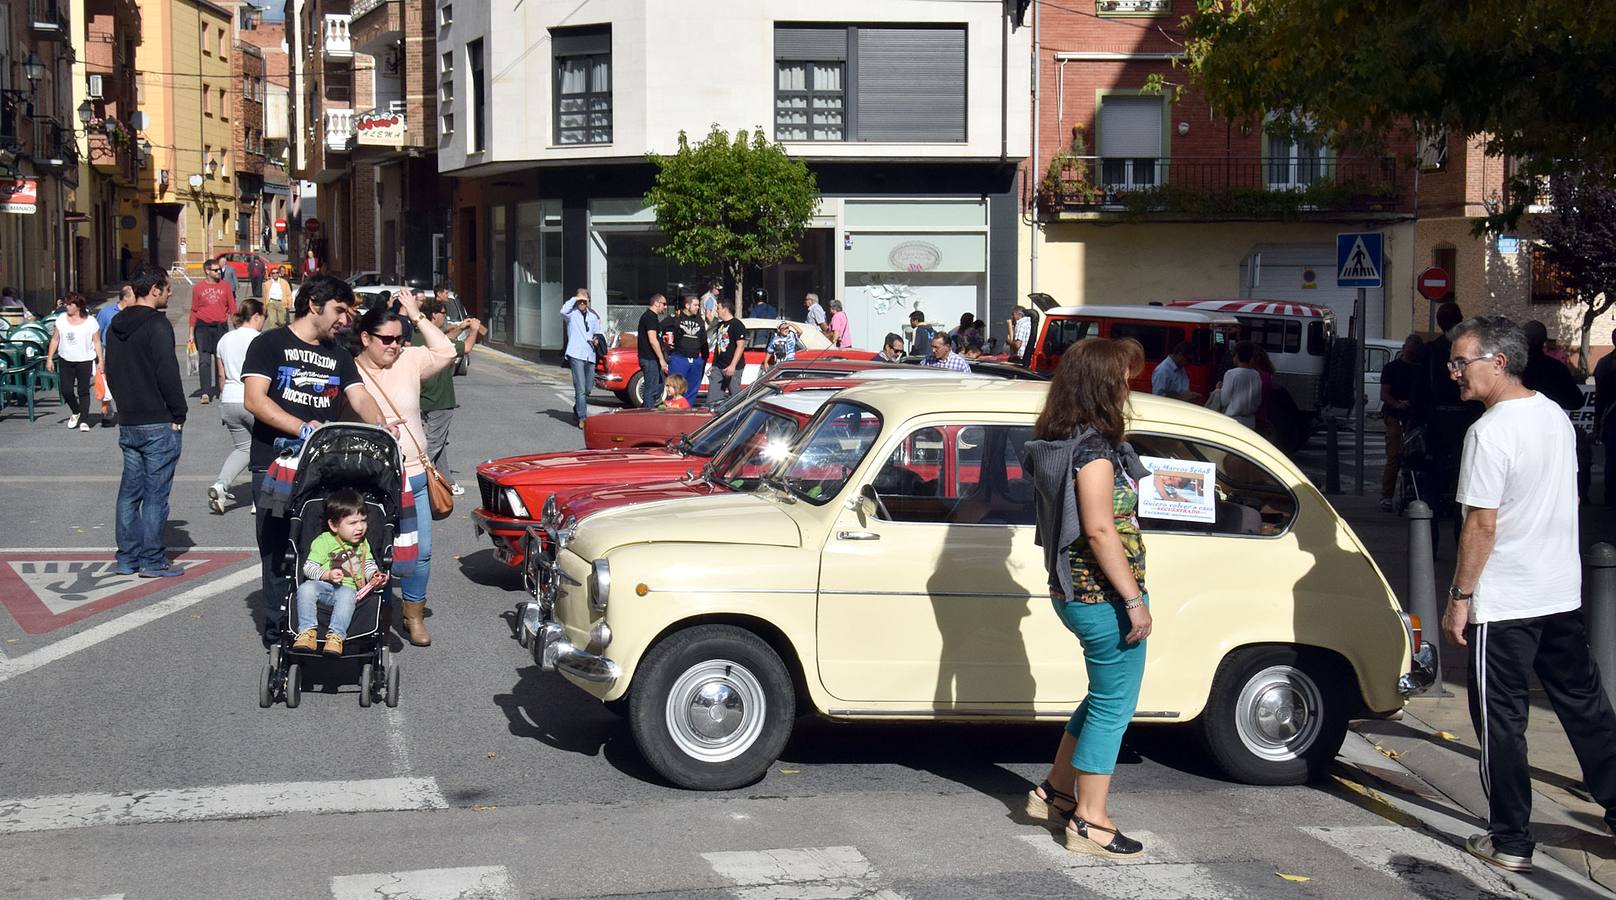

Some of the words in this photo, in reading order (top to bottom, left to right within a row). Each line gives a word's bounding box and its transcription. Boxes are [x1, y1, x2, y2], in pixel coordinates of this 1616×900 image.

[282, 387, 313, 406] HOCKEY
[1163, 463, 1188, 471] Marcos
[1169, 502, 1193, 510] volver
